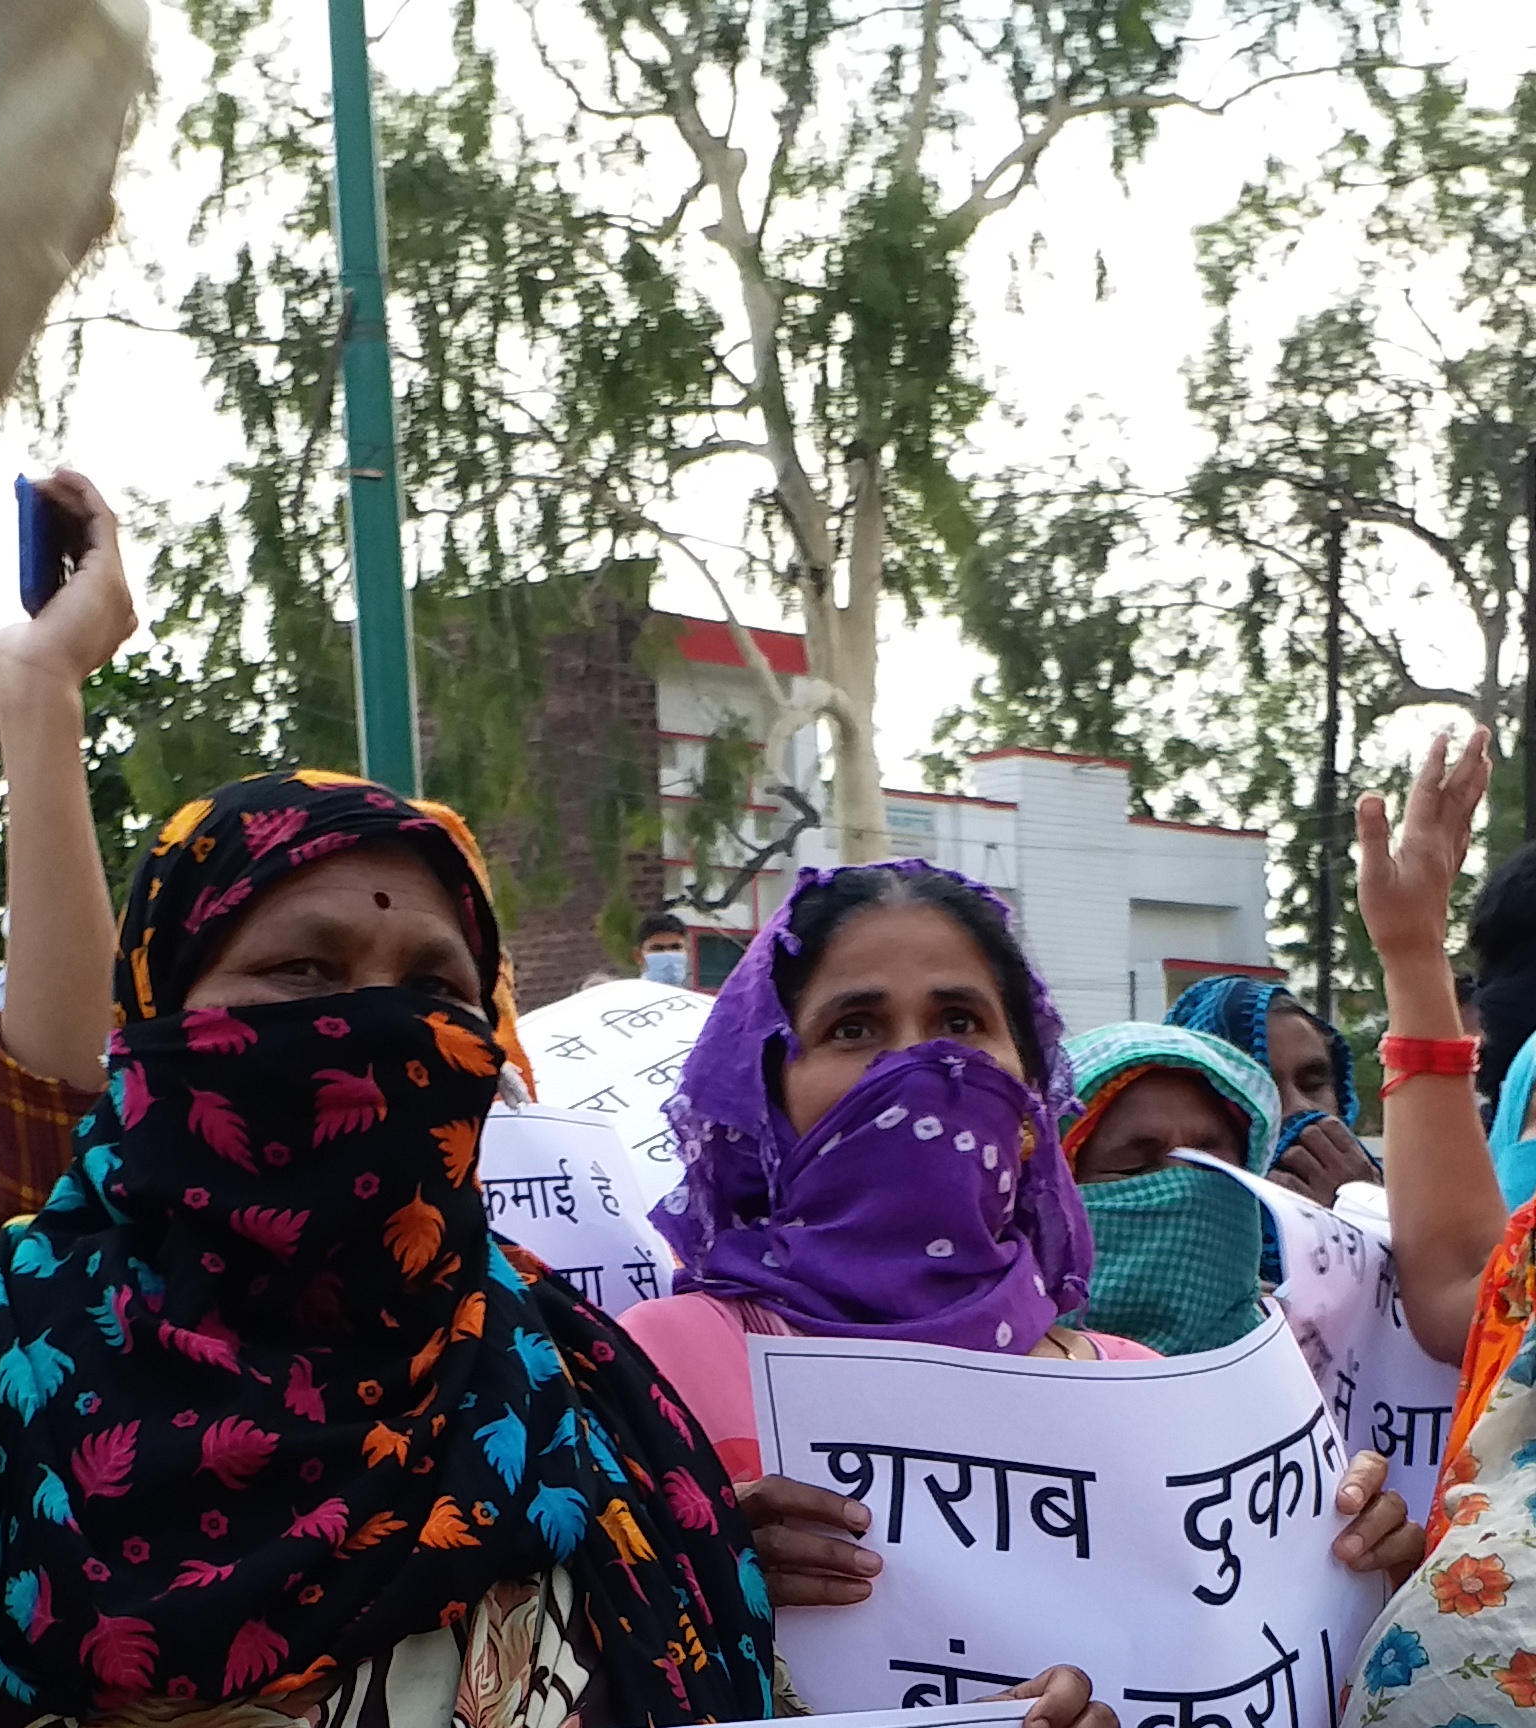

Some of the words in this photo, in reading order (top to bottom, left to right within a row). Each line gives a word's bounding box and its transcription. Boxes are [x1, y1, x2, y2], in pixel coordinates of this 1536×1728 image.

[545, 1035, 598, 1060] से
[482, 1158, 578, 1224] कमाई
[810, 1443, 1096, 1559] शराब
